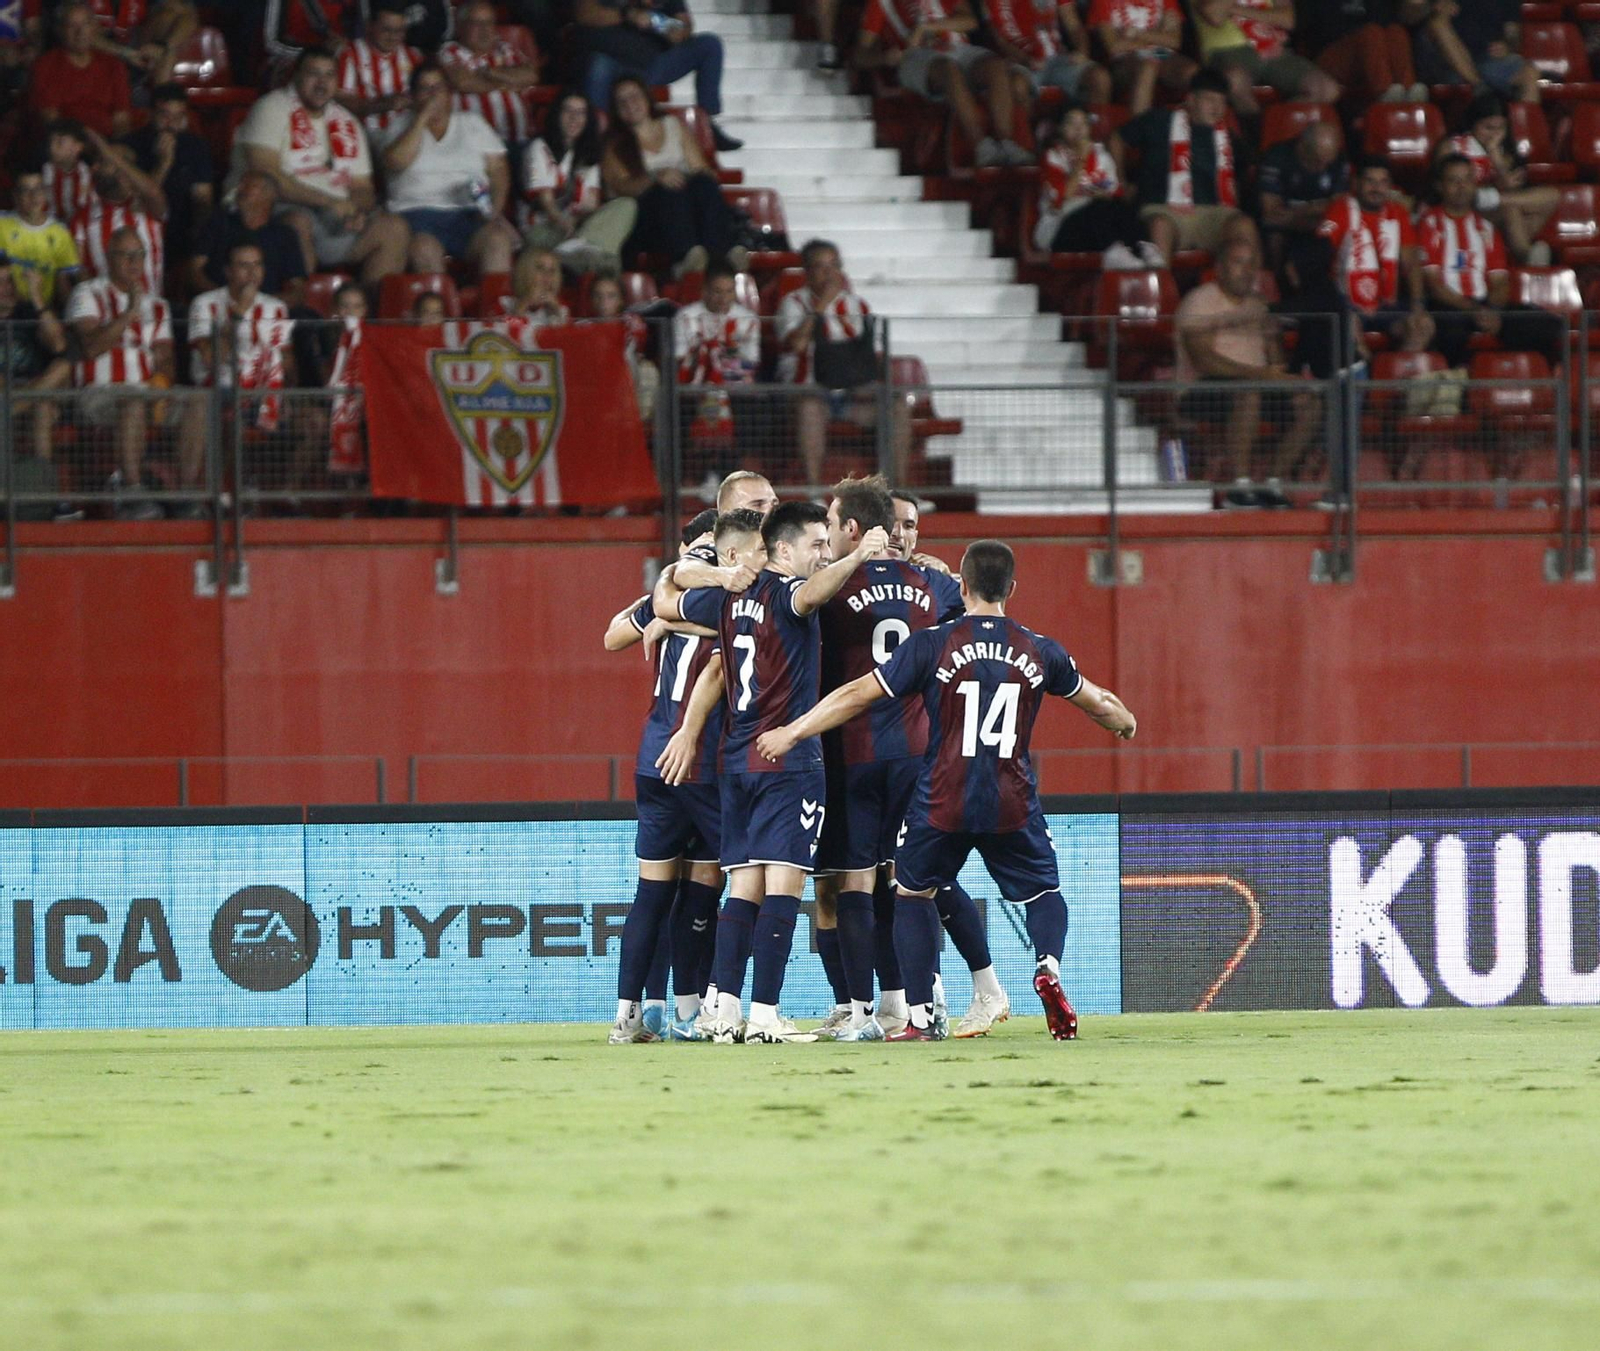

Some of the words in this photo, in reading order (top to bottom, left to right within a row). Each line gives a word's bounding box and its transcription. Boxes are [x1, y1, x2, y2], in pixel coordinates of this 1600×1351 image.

[847, 584, 931, 613] BAUTISTA
[733, 634, 756, 711] 7
[956, 680, 1021, 759] 14
[0, 898, 183, 986] IGA
[231, 909, 298, 943] EA
[1330, 832, 1600, 1009] KUD
